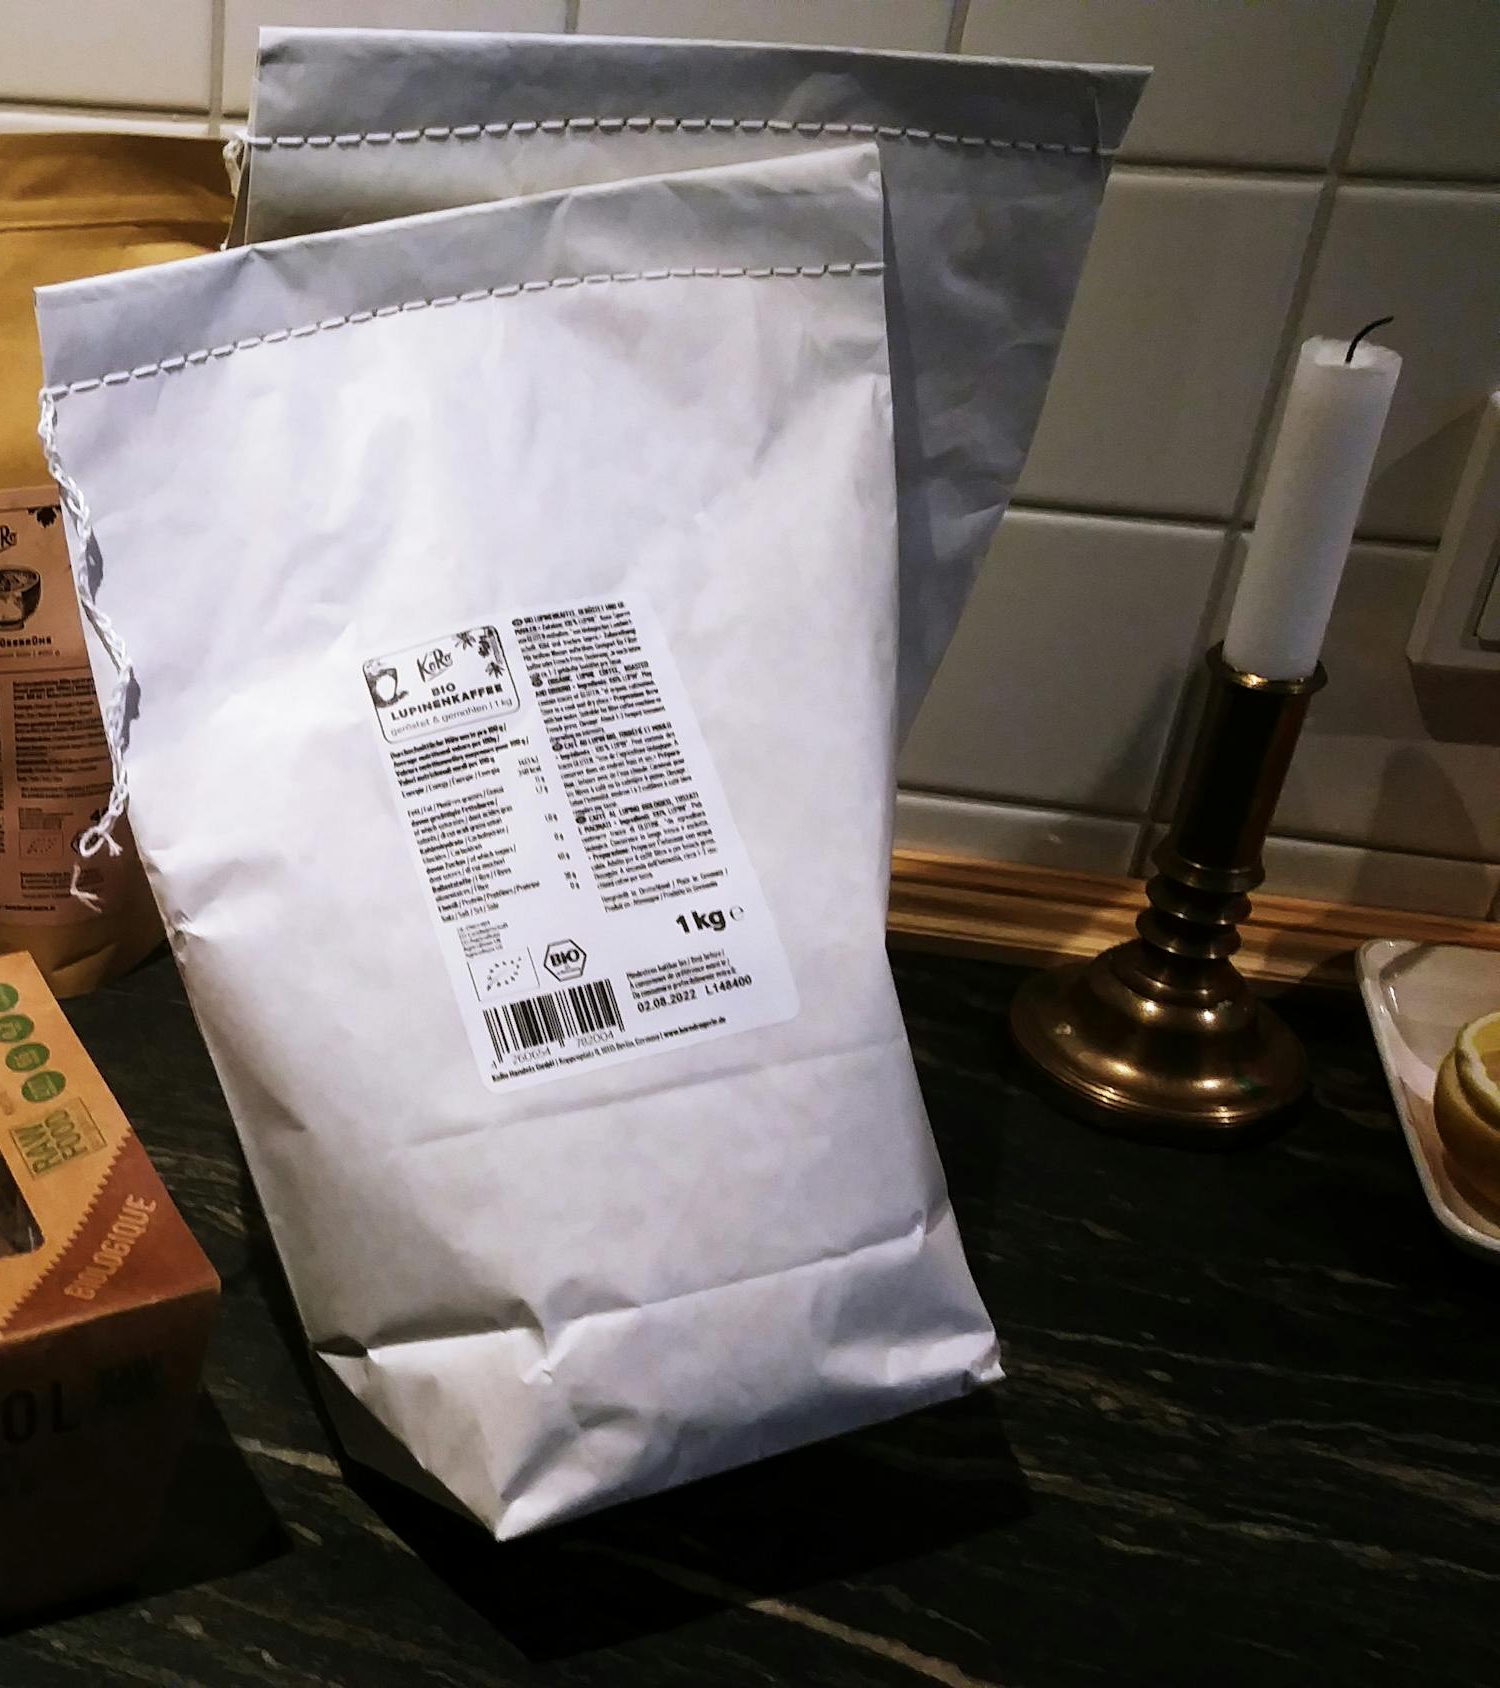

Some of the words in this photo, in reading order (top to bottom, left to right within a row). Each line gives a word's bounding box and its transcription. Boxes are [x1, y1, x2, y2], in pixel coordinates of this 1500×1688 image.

[417, 649, 454, 682] KoRo
[391, 683, 503, 721] LUPINENKAFFEE
[431, 683, 456, 697] BIO
[441, 704, 488, 723] gemahlen
[676, 915, 690, 933] 1
[691, 910, 726, 931] kg
[550, 948, 579, 967] BIO
[637, 988, 697, 1013] 02.08.2022
[705, 974, 752, 995] L148400
[64, 1194, 156, 1300] BIOLOGIQUE
